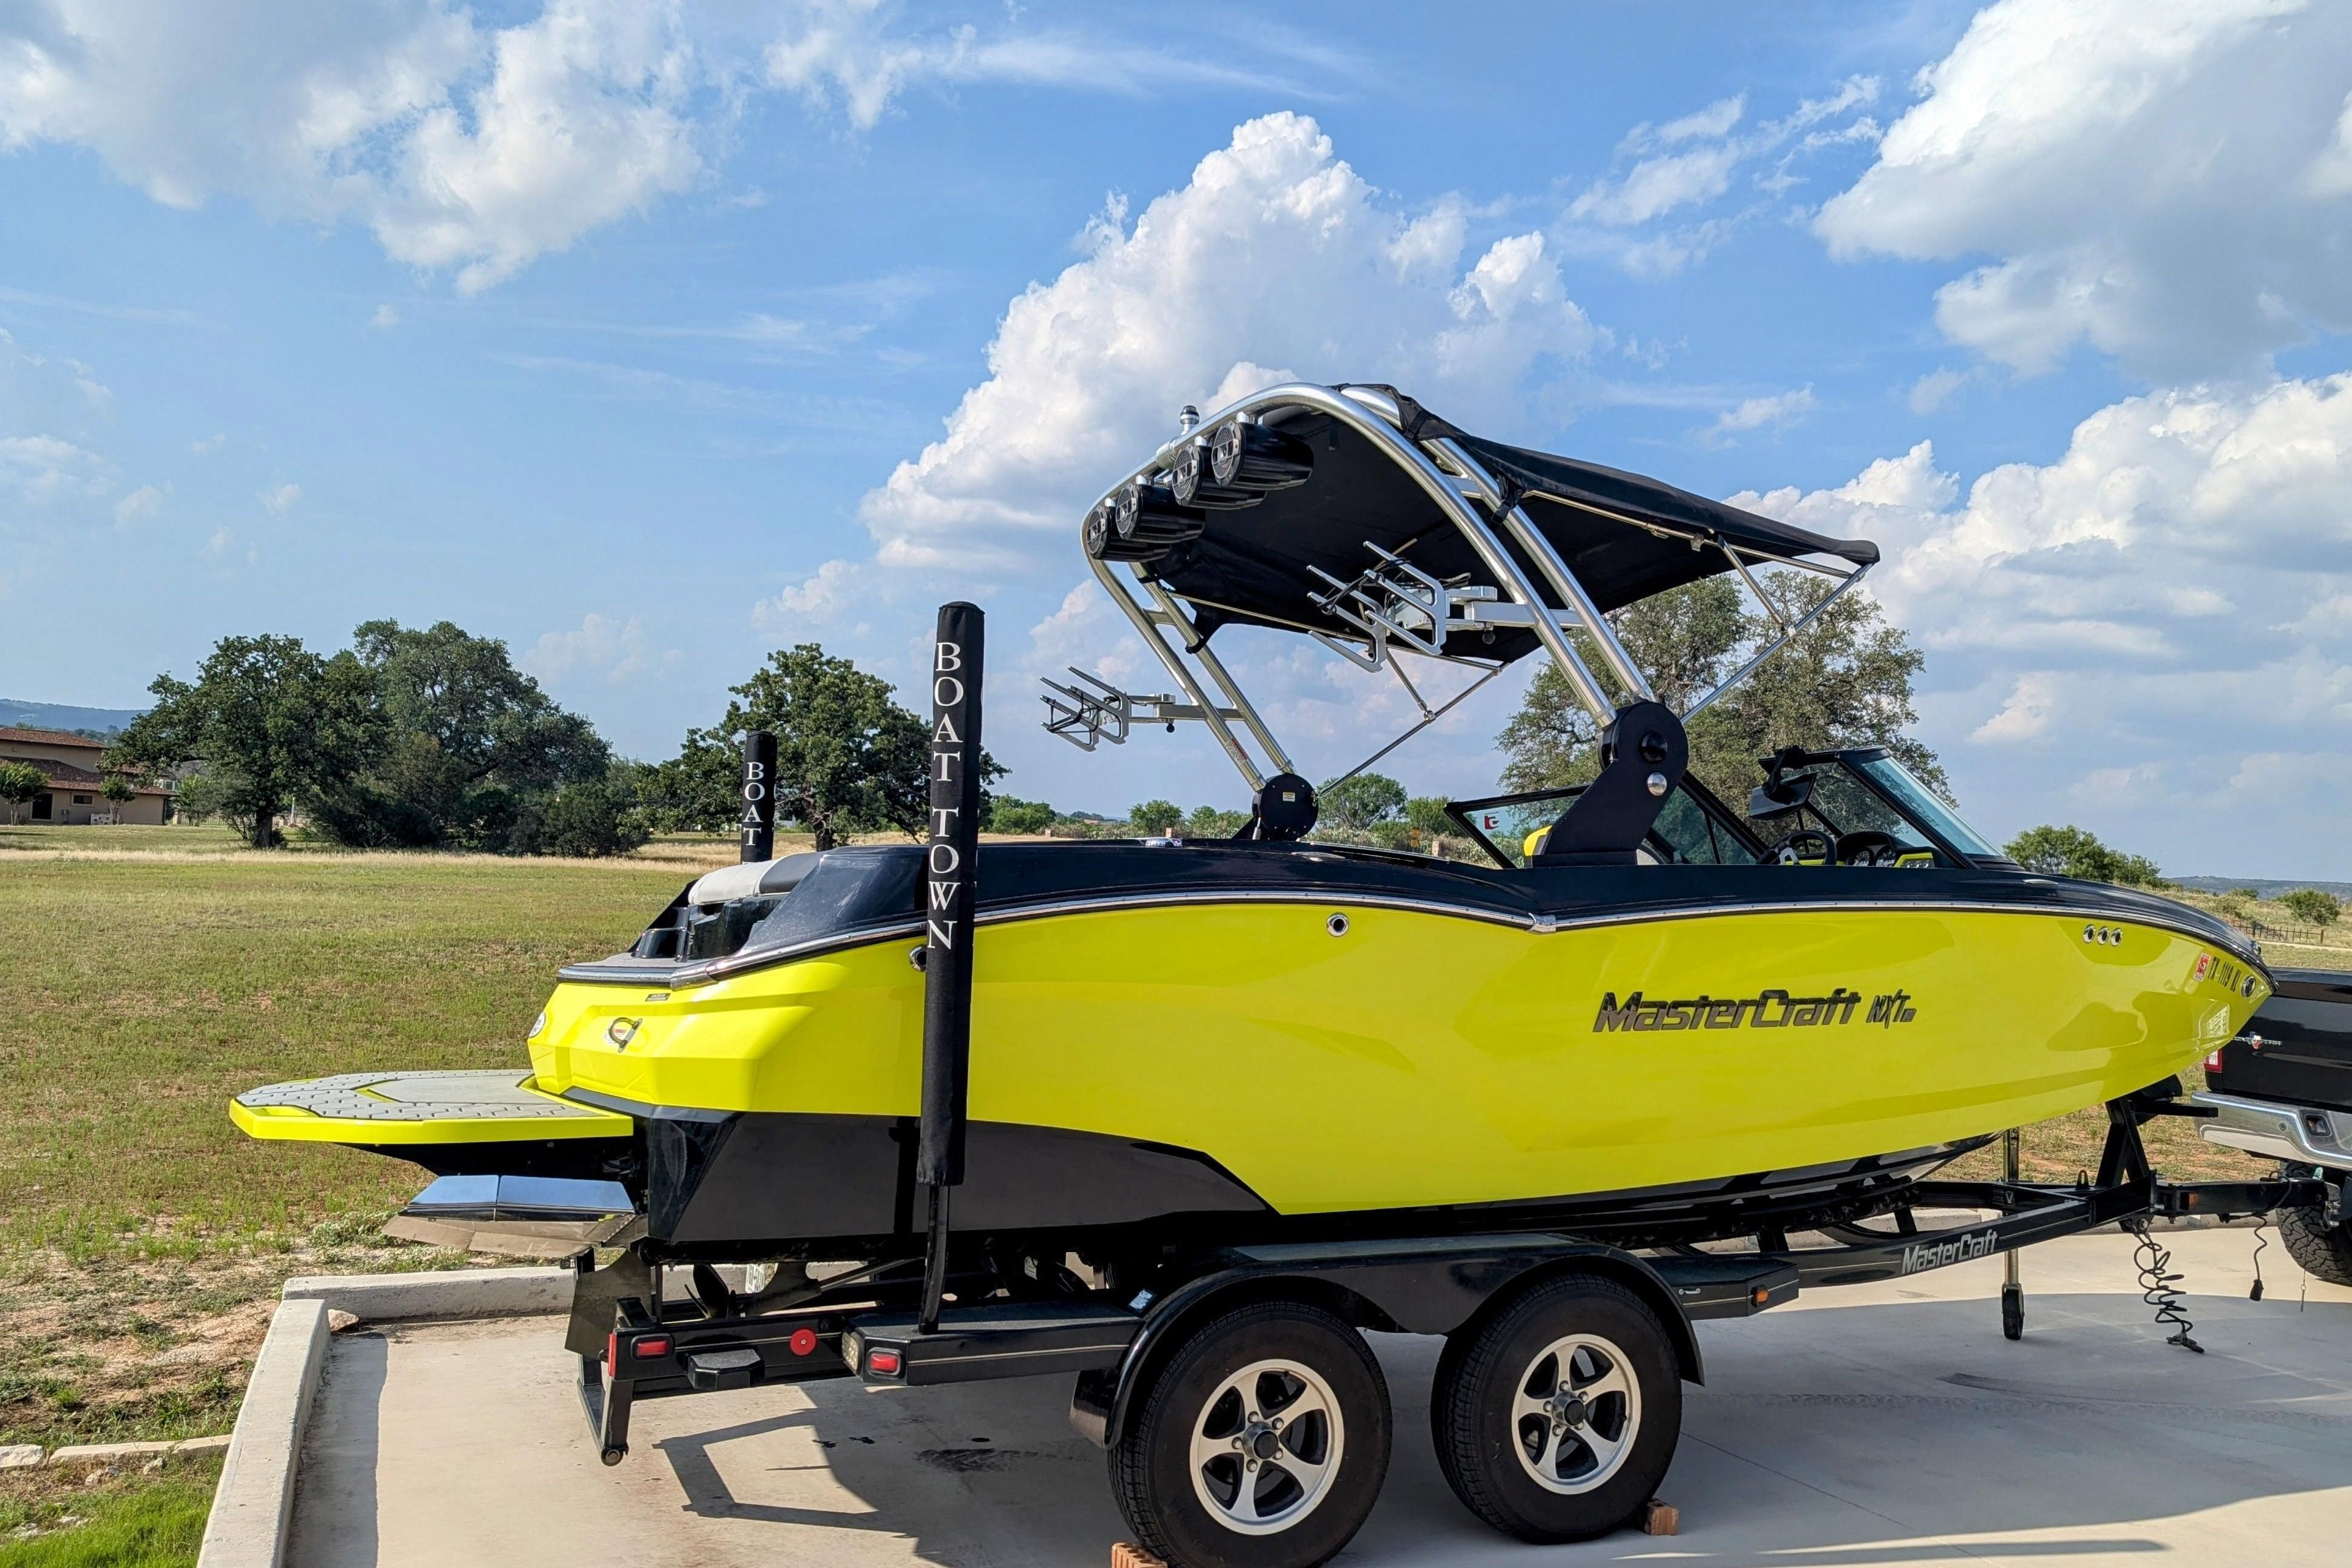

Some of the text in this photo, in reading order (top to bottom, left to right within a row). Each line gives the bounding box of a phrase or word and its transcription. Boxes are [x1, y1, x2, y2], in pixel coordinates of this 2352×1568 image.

[742, 762, 765, 846] BOAT
[927, 642, 964, 950] BOAT TOWN
[2207, 956, 2221, 981] TX
[1592, 988, 1862, 1032] MasterCraft
[1901, 1228, 1998, 1275] MasterCraft
